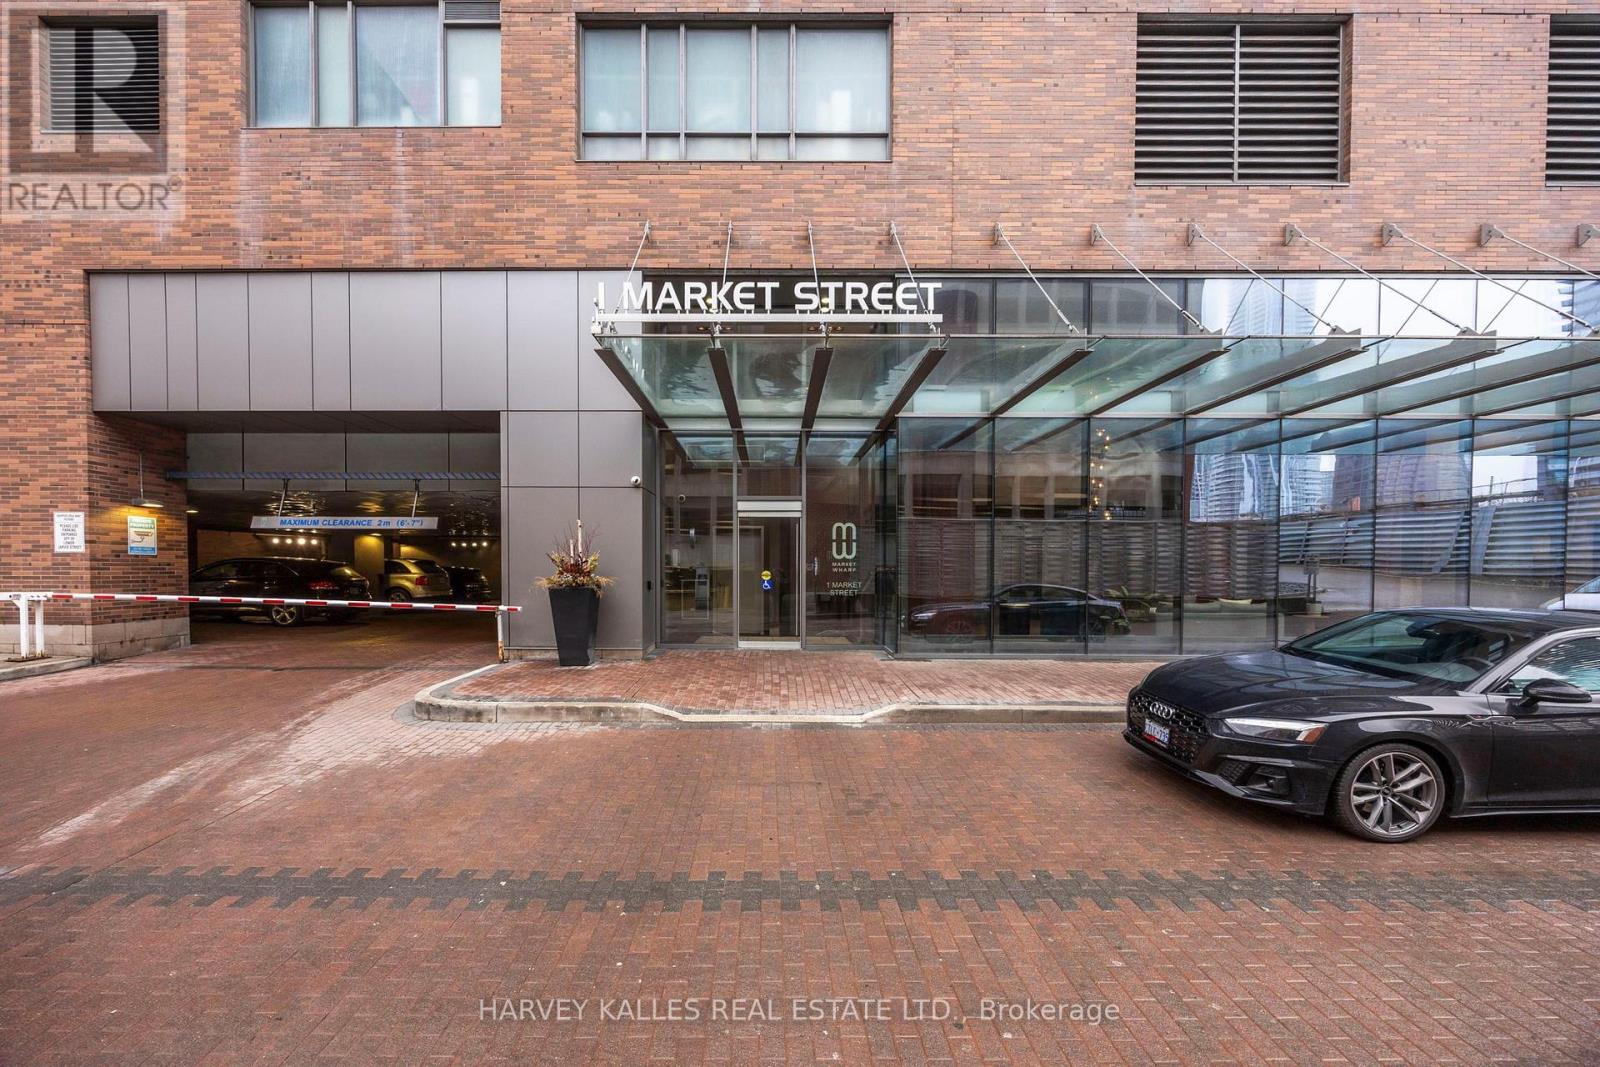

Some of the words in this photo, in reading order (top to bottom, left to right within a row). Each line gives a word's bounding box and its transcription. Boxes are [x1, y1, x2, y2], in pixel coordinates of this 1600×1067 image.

[622, 281, 780, 311] MARKET
[794, 281, 943, 311] STREET
[321, 519, 373, 527] CLEARANCE
[377, 519, 391, 527] 2m
[830, 589, 858, 597] STREET
